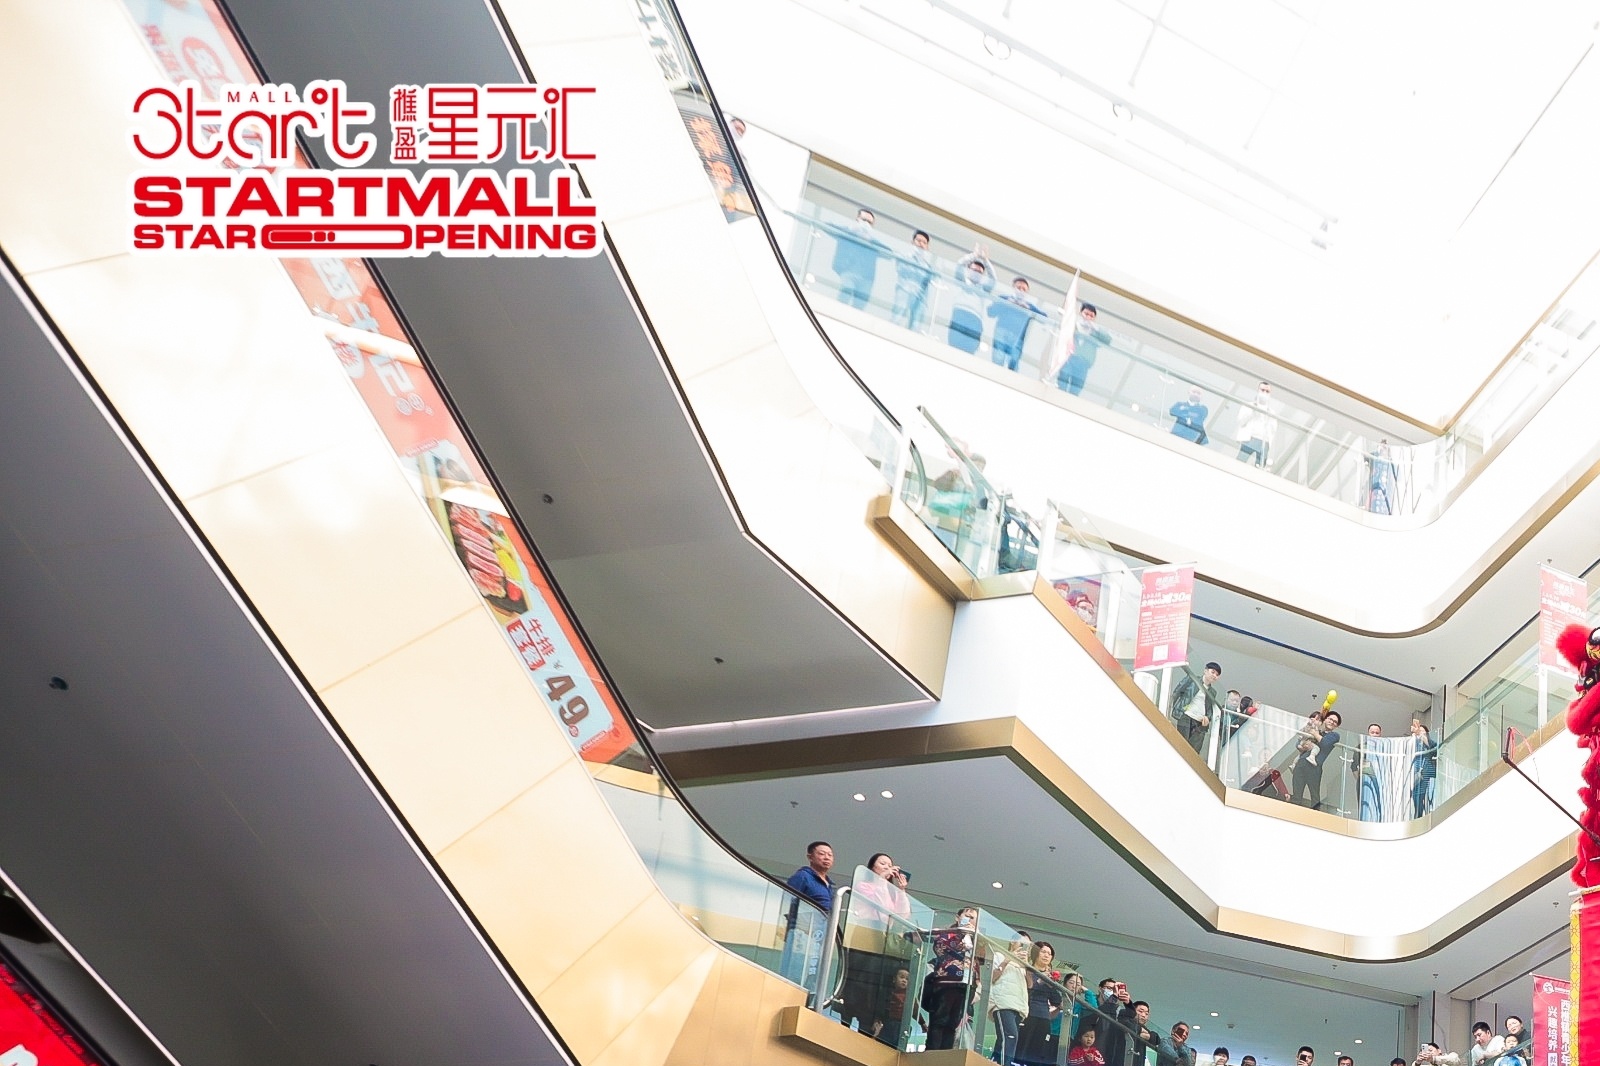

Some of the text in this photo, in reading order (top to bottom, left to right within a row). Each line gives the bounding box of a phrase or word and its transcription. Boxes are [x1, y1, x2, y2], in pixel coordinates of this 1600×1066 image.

[546, 675, 589, 727] 49
[1547, 1005, 1558, 1051] 兴趣培养
